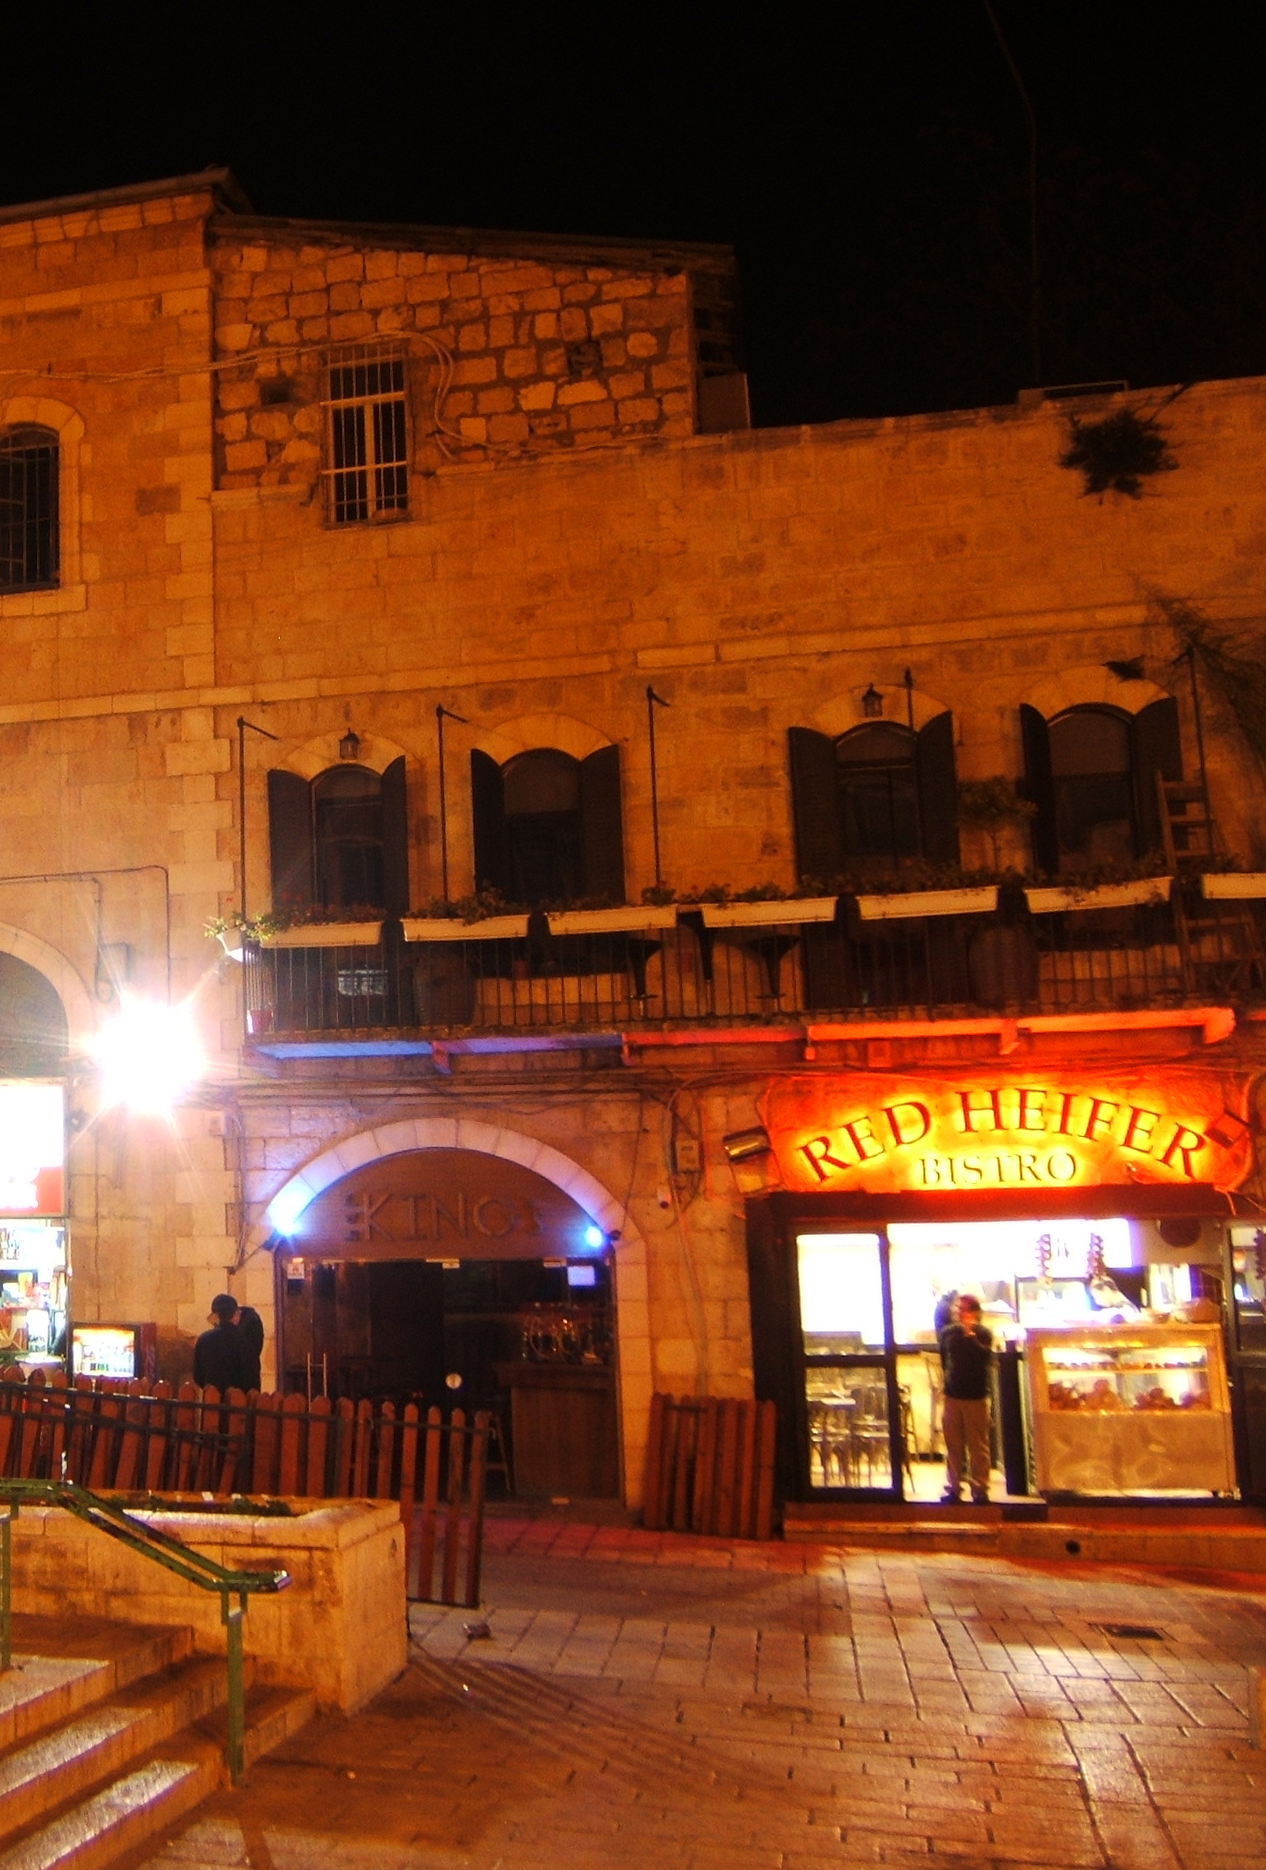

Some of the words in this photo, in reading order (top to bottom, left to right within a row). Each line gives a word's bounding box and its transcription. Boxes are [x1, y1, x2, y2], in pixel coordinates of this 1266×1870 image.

[798, 1101, 932, 1183] RED
[954, 1087, 1208, 1180] HEIFER
[919, 1152, 1077, 1186] BISTRO
